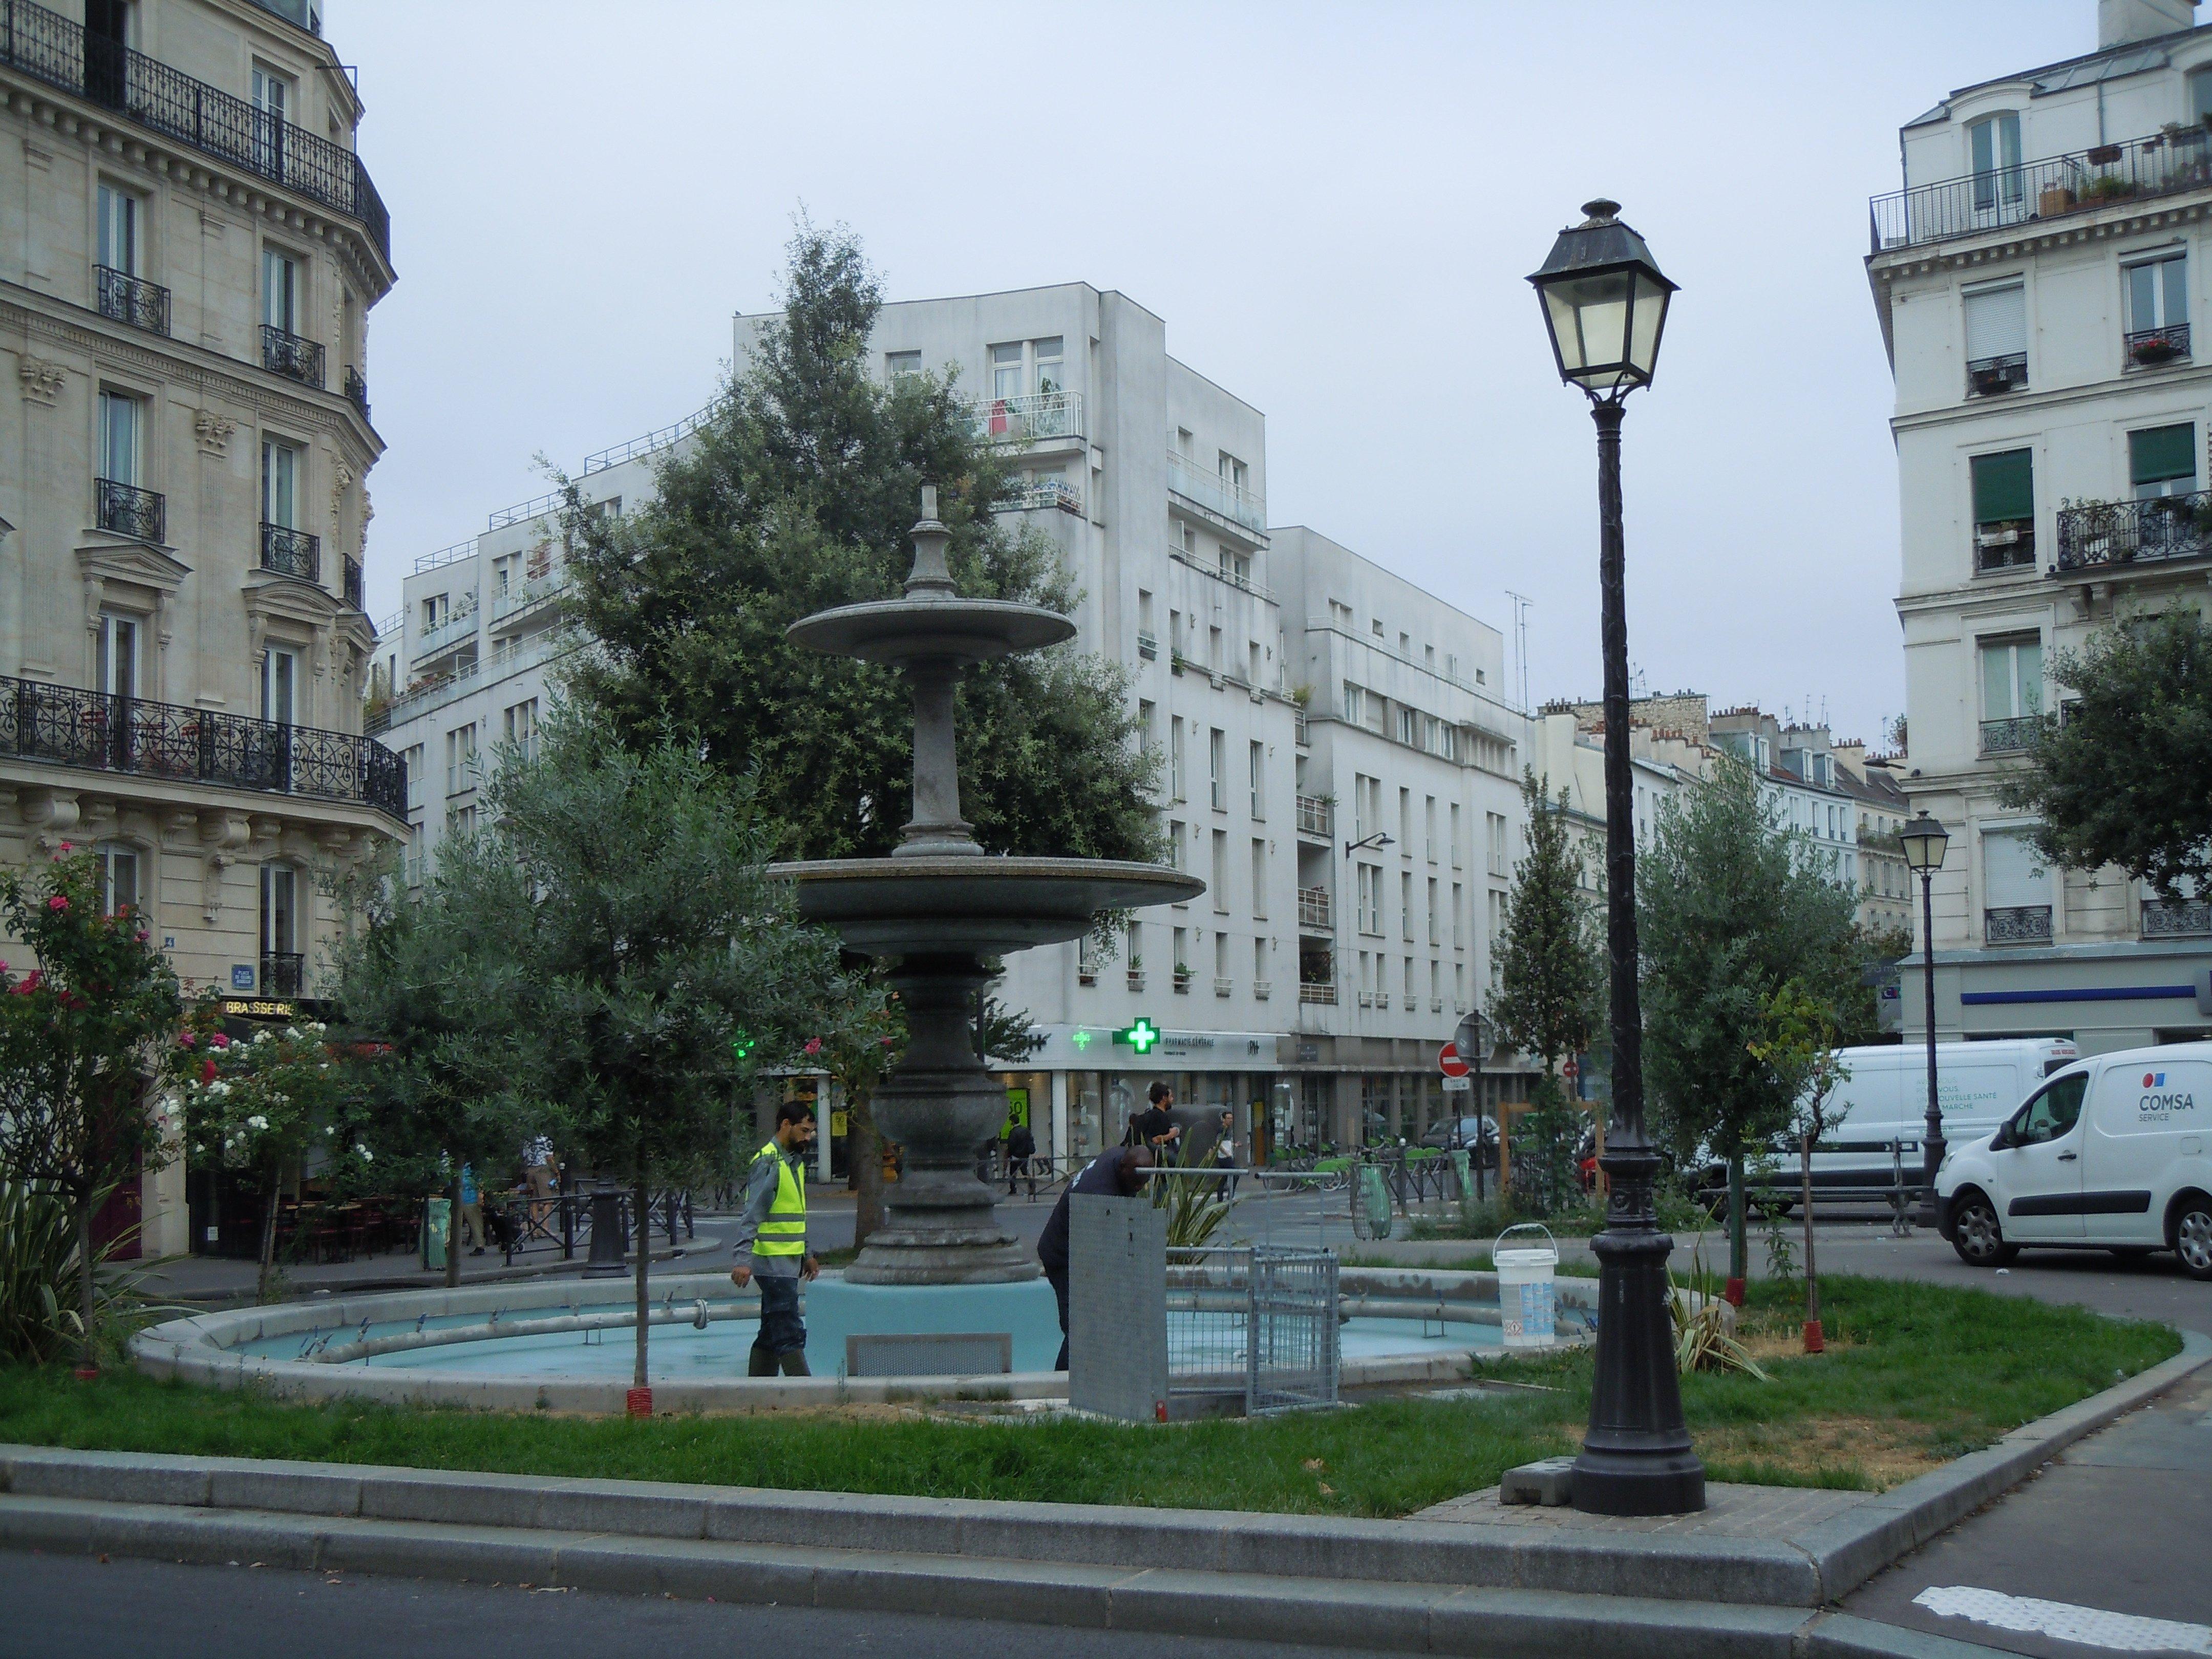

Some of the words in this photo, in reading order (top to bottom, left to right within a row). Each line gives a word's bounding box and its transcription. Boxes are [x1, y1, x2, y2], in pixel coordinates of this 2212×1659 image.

[167, 938, 173, 947] 4
[1939, 1093, 1971, 1101] OUVELLE
[2139, 1093, 2194, 1111] COMSA
[2139, 1113, 2169, 1122] SERVICE
